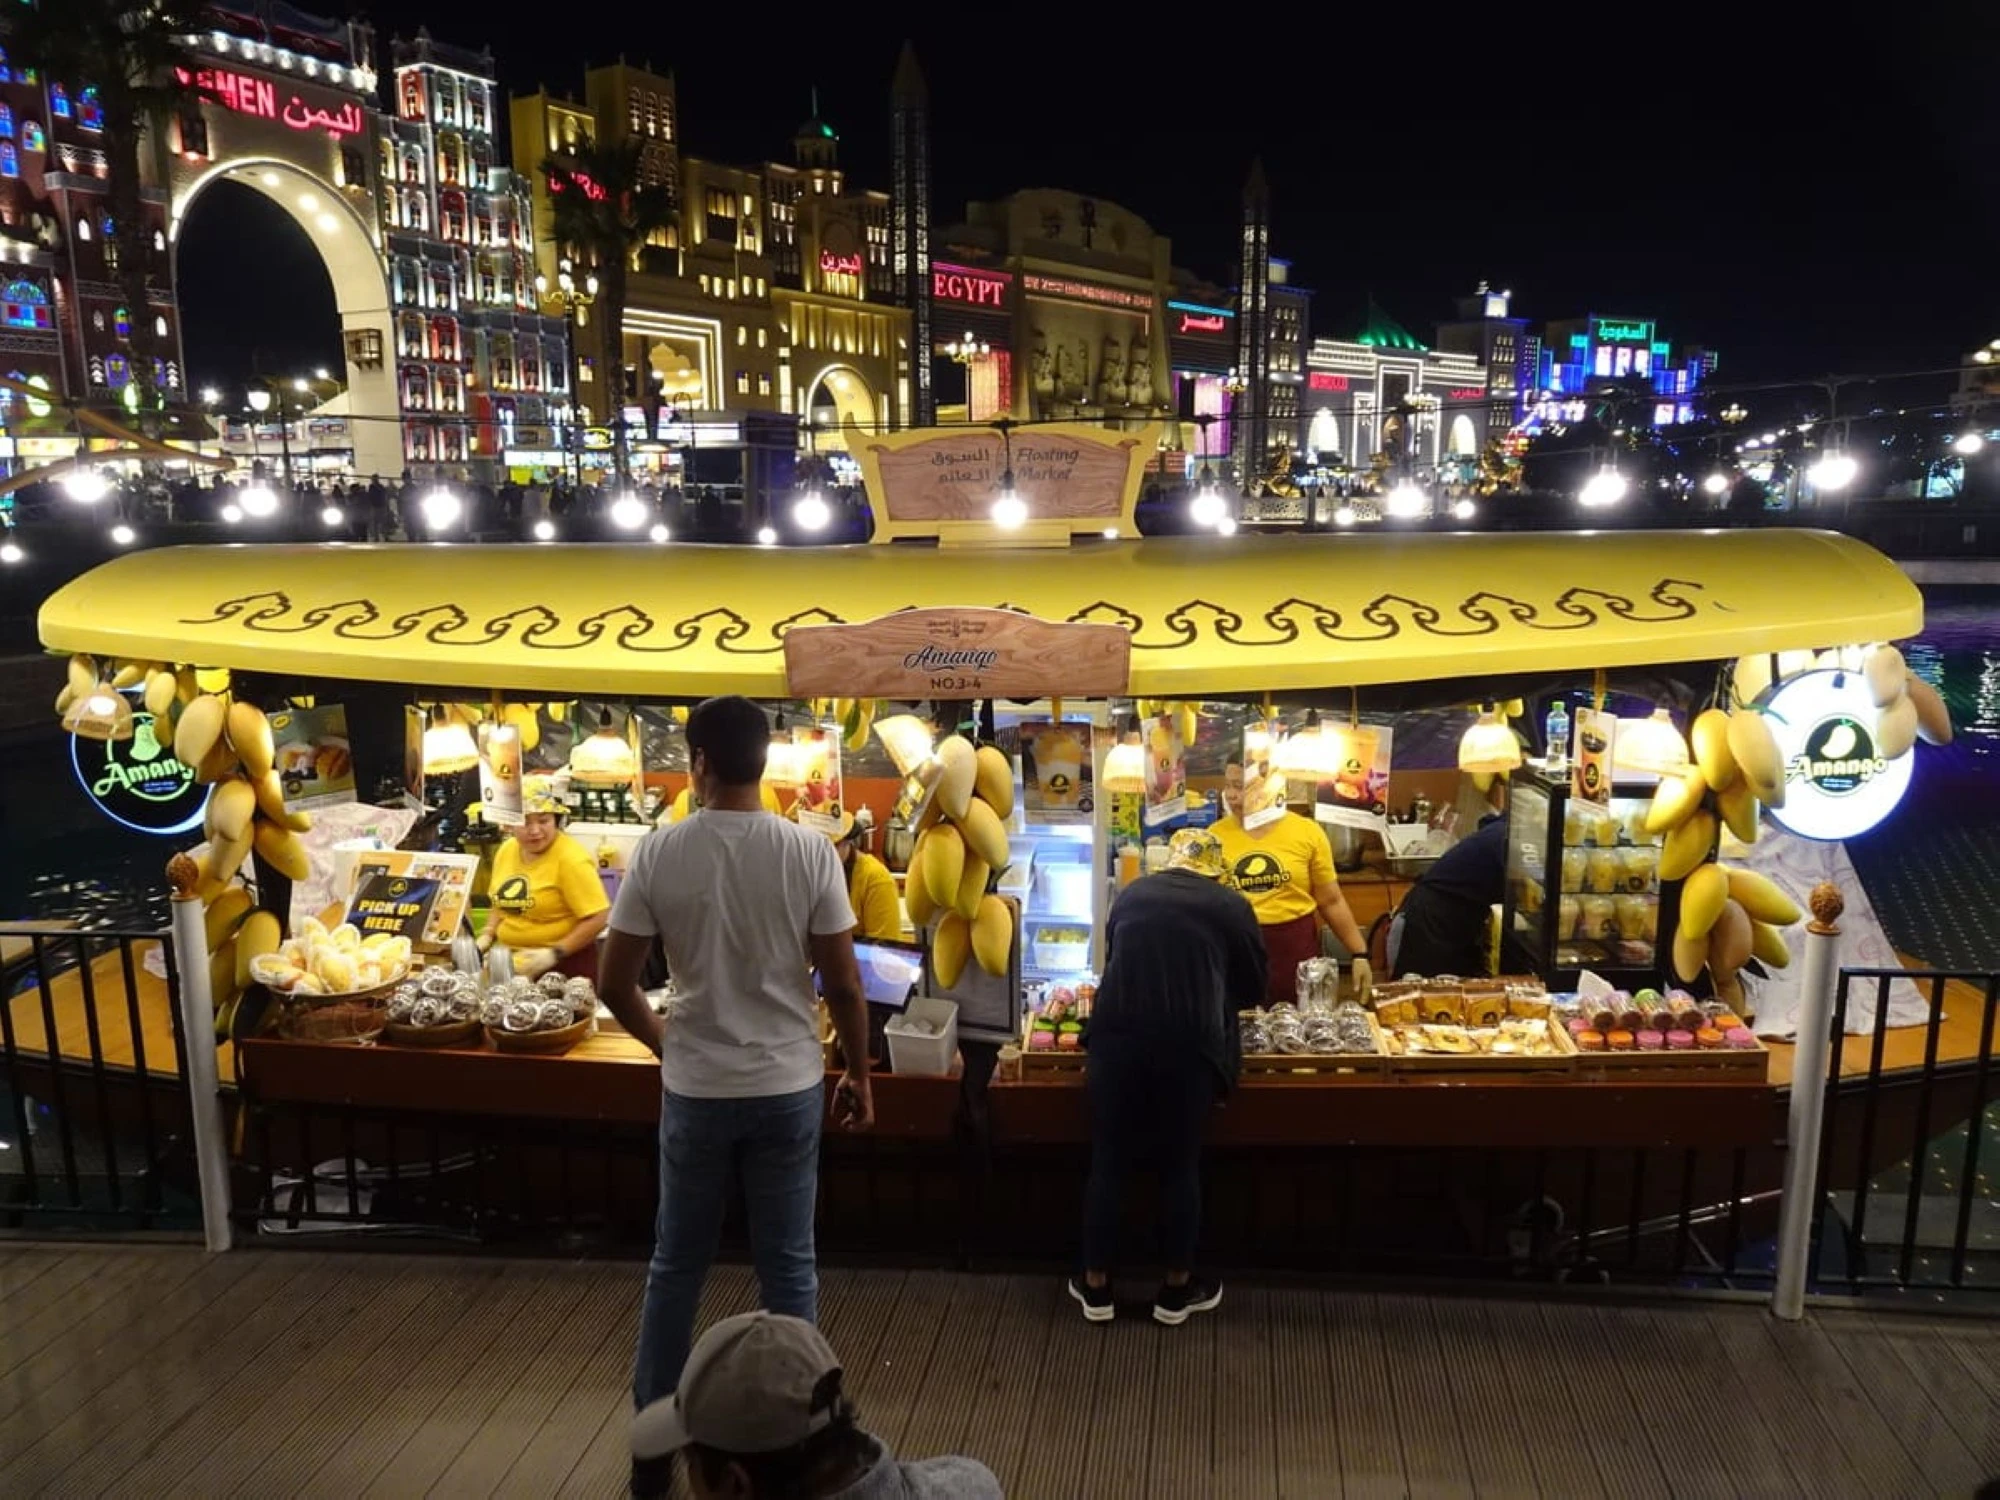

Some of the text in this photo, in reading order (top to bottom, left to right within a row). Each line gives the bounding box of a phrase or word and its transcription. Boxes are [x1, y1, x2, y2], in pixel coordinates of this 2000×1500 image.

[283, 97, 361, 140] اليمن
[933, 273, 1004, 304] EGYPT
[931, 450, 989, 466] السوق
[1016, 449, 1079, 465] Floating
[1017, 467, 1072, 480] Market
[903, 645, 997, 671] Amango
[93, 758, 194, 797] Amang
[1785, 755, 1887, 783] Amango
[358, 900, 421, 916] PICK UP
[363, 917, 404, 931] HERE
